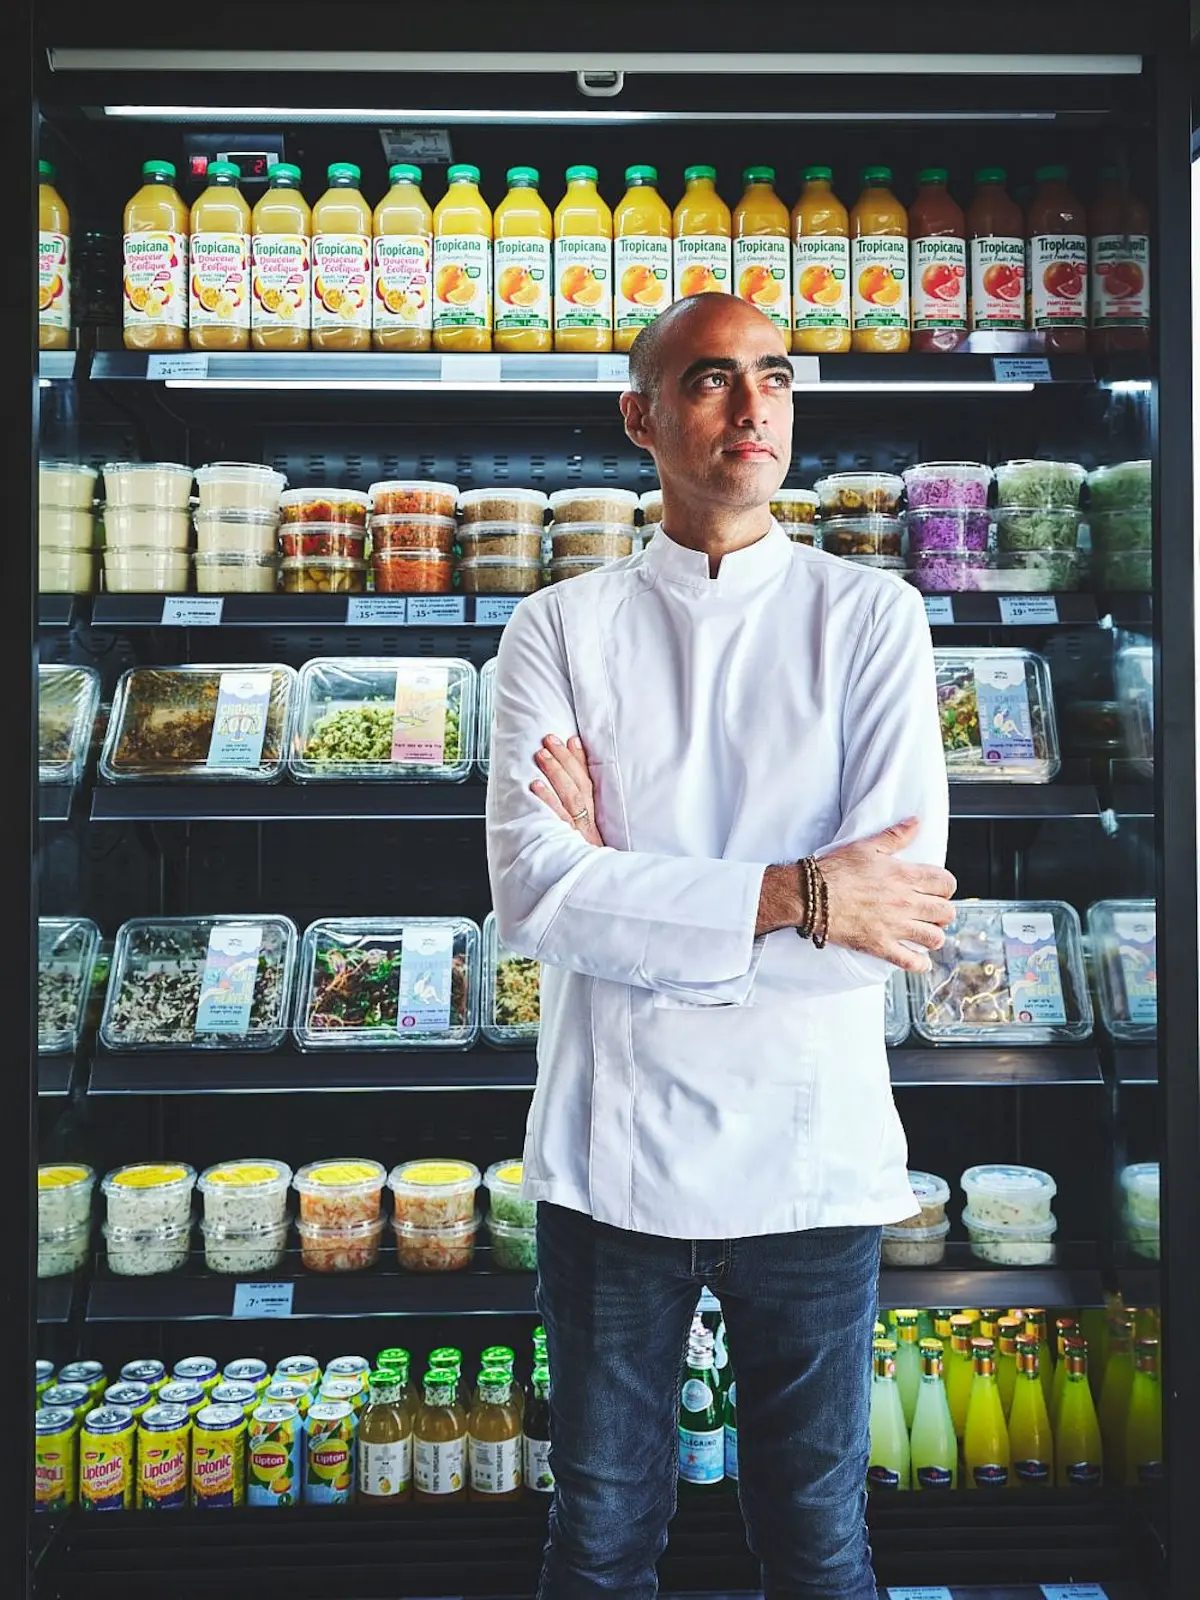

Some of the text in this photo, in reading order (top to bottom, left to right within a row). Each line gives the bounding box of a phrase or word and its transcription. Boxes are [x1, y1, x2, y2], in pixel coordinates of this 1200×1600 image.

[126, 241, 168, 254] Tropicana
[194, 241, 240, 254] Tropicana
[255, 243, 302, 256] Tropicana
[316, 243, 362, 256] Tropicana
[378, 244, 424, 256] Tropicana
[436, 238, 480, 252] Tropicana
[498, 240, 544, 254] Tropicana
[559, 240, 606, 253] Tropicana
[620, 240, 667, 253] Tropicana
[678, 240, 726, 253] Tropicana
[737, 240, 784, 253] Tropicana
[856, 240, 904, 253] Tropicana
[917, 240, 962, 254] Tropicana
[978, 240, 1024, 254] Tropicana
[194, 1454, 232, 1477] Liptonic
[255, 1456, 283, 1466] Lipton
[316, 1454, 345, 1464] Lipton
[82, 1458, 122, 1481] Liptonic
[144, 1453, 184, 1479] Liptonic
